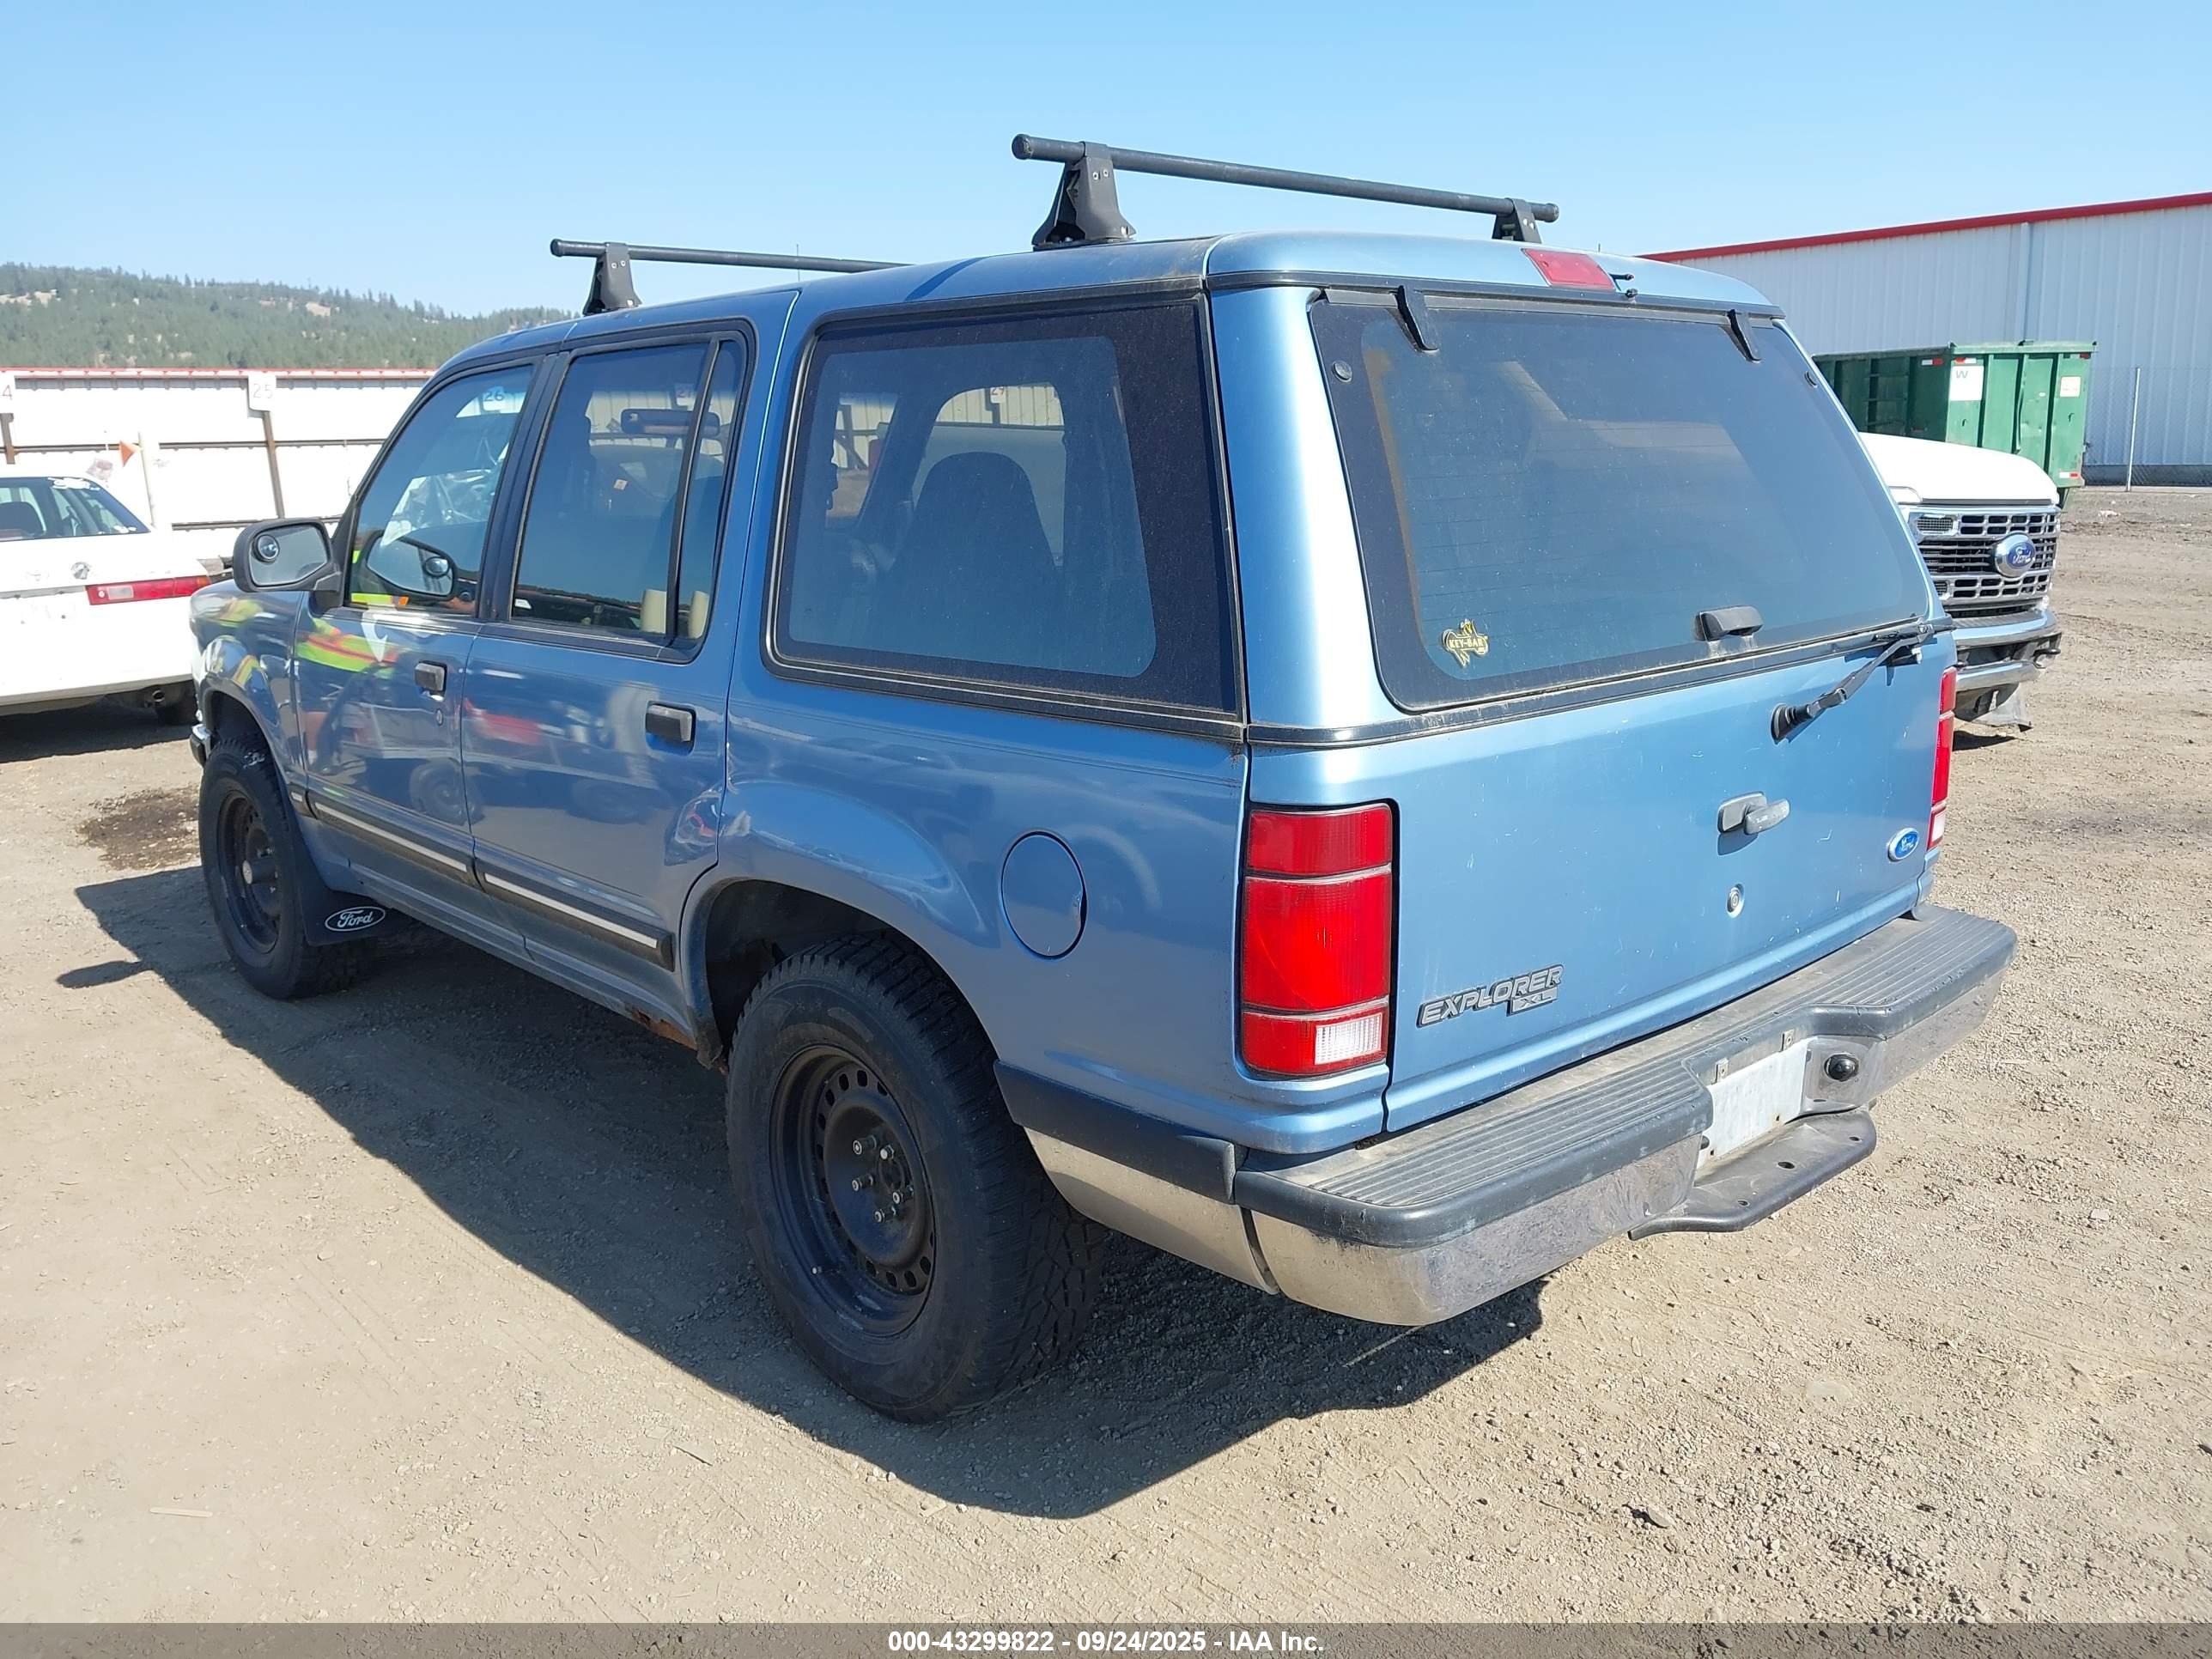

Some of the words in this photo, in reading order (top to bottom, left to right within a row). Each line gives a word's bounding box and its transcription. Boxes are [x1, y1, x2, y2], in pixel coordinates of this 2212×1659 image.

[252, 383, 274, 399] 25
[2012, 546, 2032, 564] Ford
[337, 909, 374, 928] Ford
[1418, 964, 1565, 1026] EXPLORER
